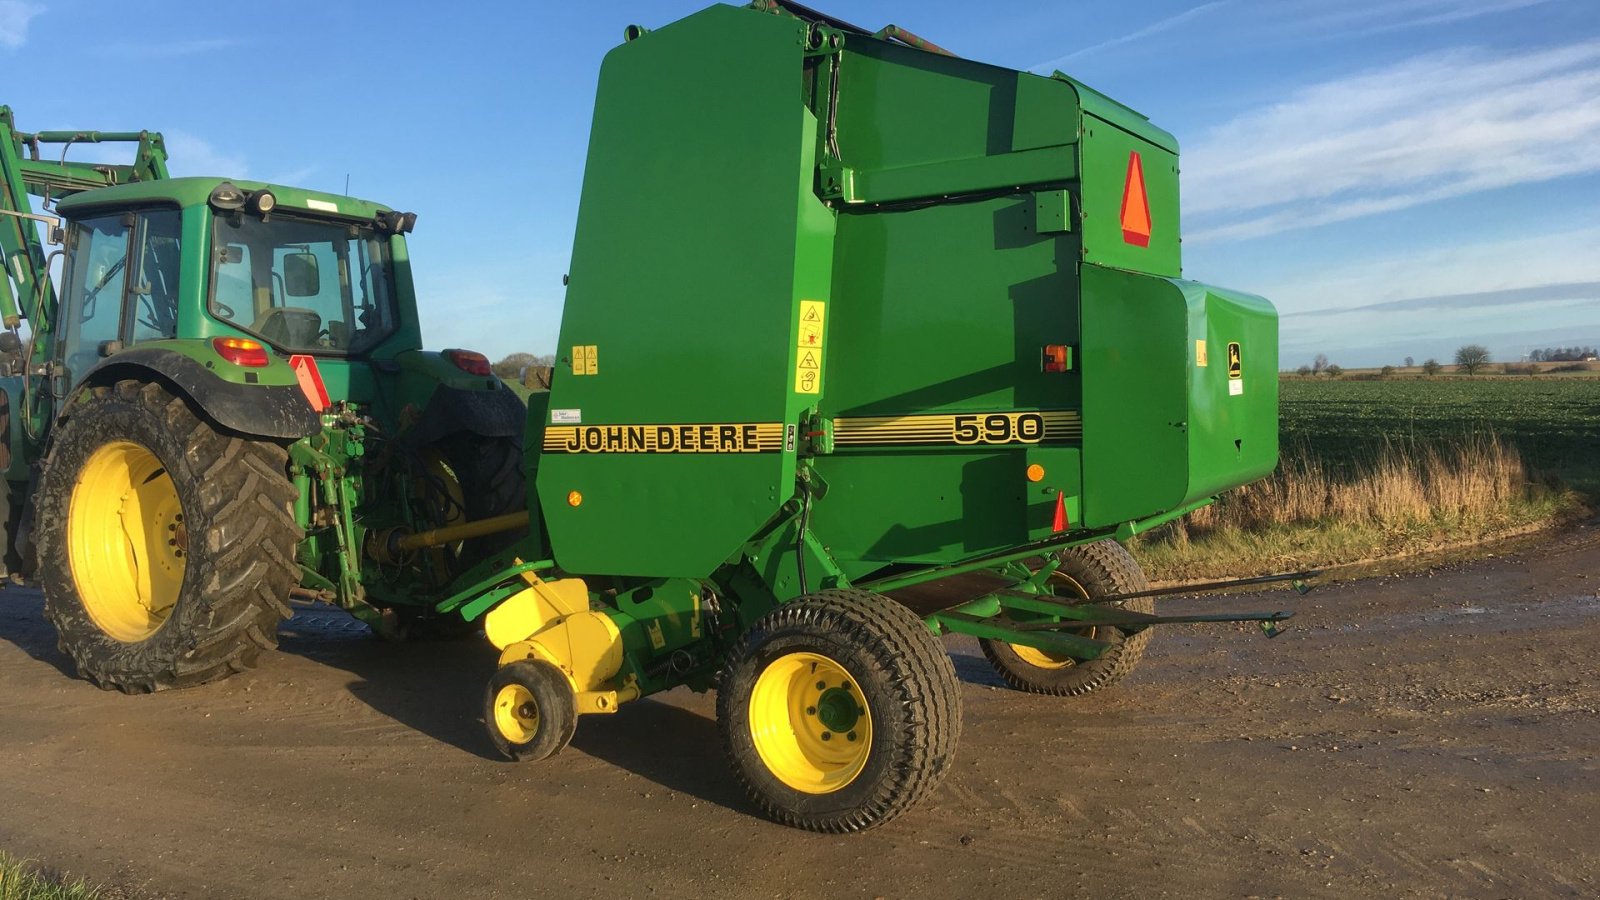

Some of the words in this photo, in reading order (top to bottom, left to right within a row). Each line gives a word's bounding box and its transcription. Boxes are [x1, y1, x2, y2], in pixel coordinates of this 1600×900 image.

[567, 425, 647, 454] JOHN
[656, 424, 760, 452] DEERE
[953, 413, 1045, 443] 590
